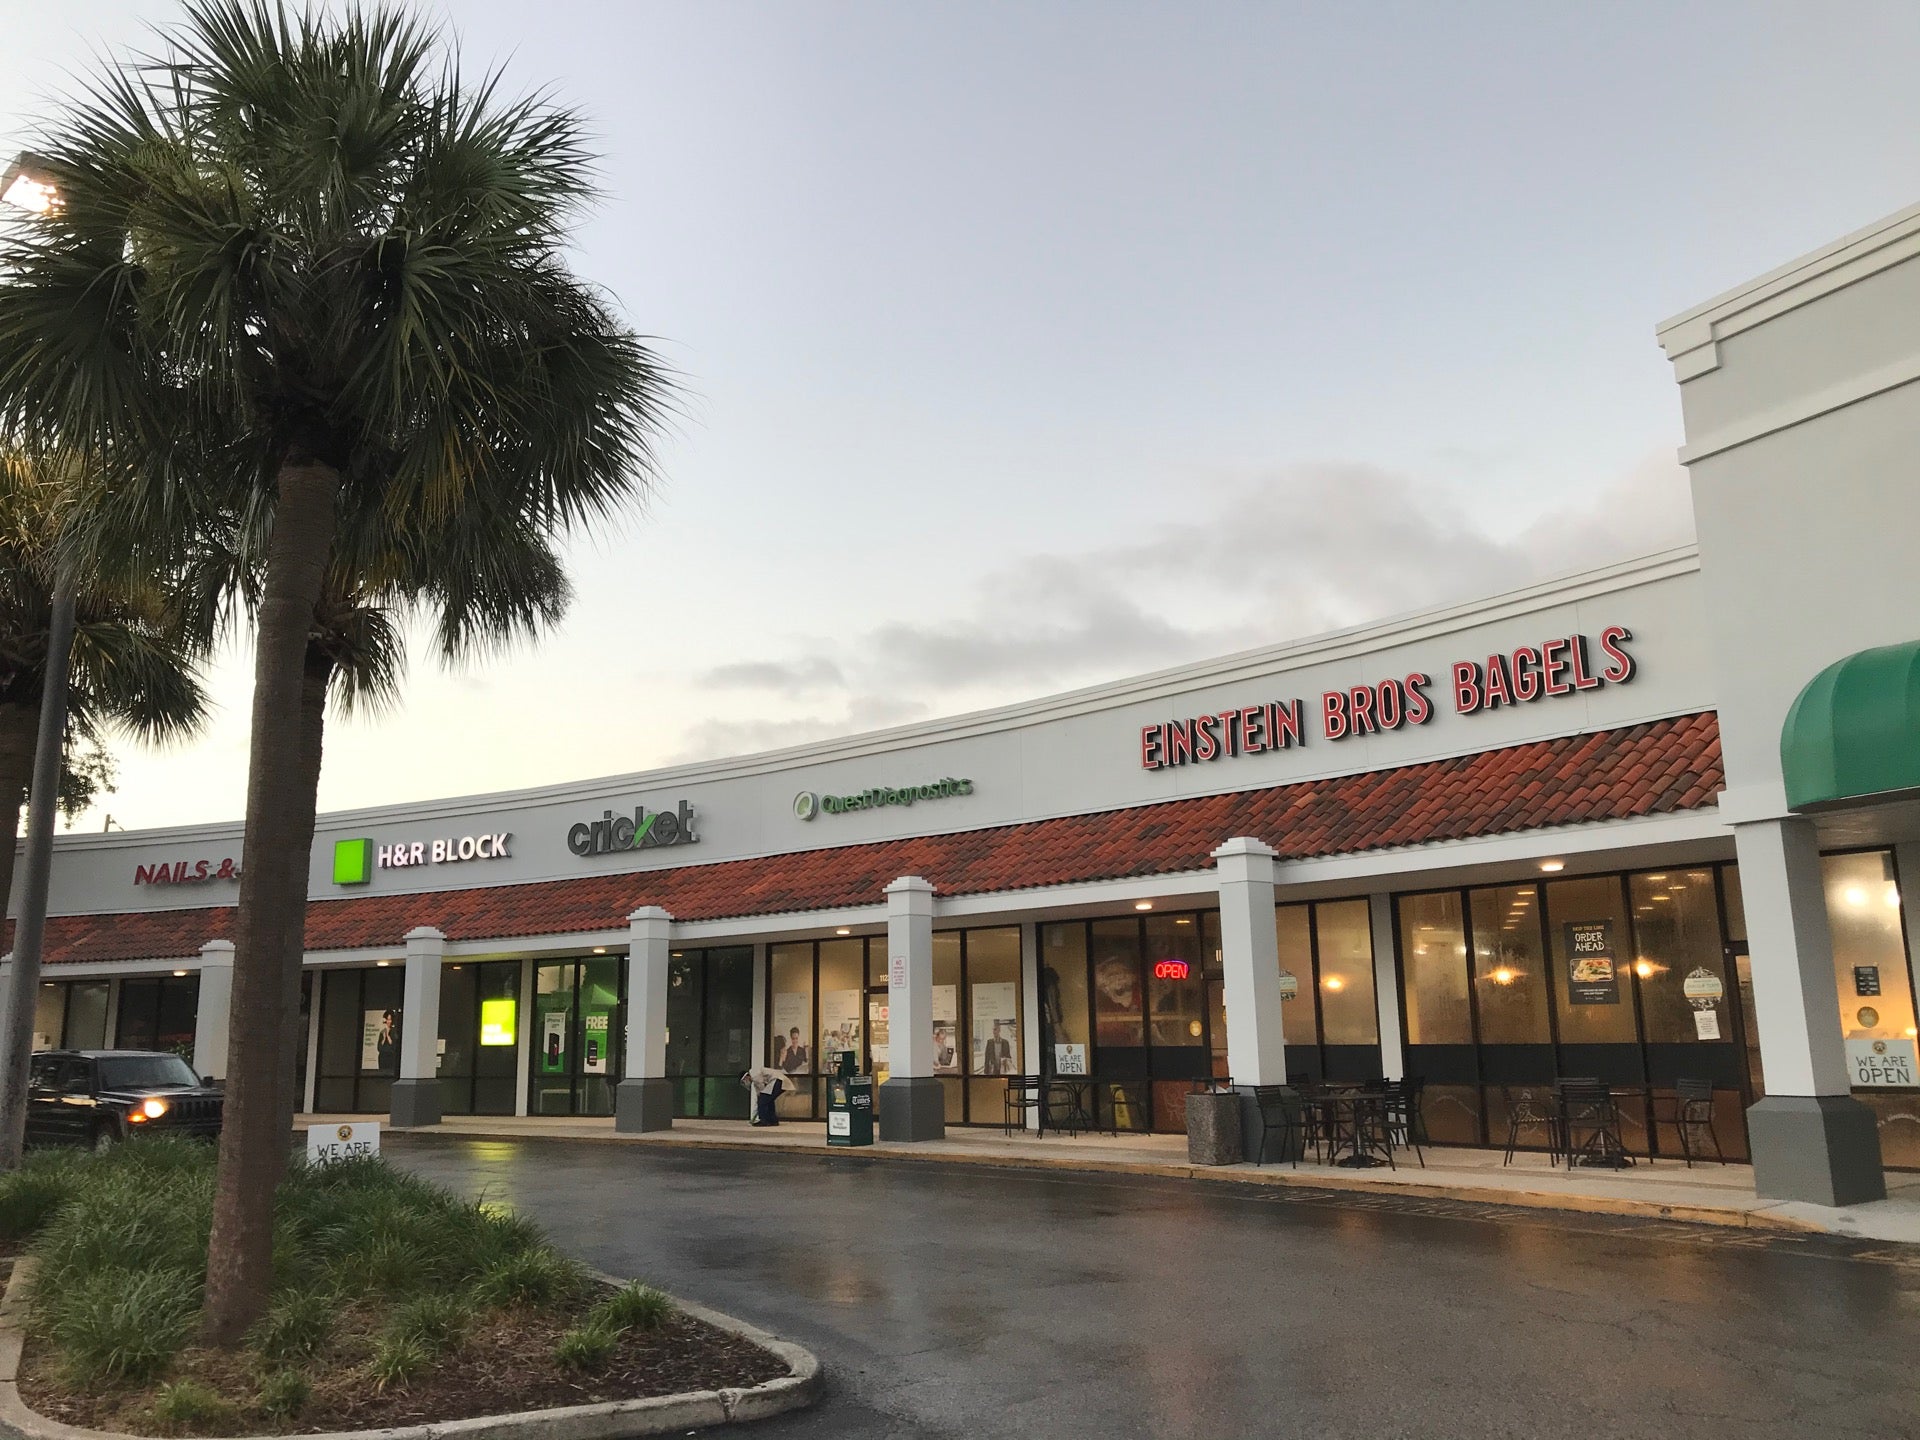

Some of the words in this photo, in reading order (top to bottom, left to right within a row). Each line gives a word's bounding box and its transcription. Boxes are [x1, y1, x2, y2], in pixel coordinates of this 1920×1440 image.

[1141, 698, 1303, 770] EINSTEIN
[1321, 673, 1431, 741] BROS
[1453, 625, 1634, 715] BAGELS
[821, 789, 872, 814] Quest
[873, 778, 972, 807] Diagnostics
[567, 800, 694, 856] cricket
[378, 841, 425, 868] H&R
[432, 832, 510, 863] BLOCK
[134, 860, 209, 885] NAILS
[216, 858, 236, 879] &
[1574, 931, 1604, 942] ORDER
[1574, 942, 1605, 952] AHEAD
[1155, 963, 1188, 979] OPEN
[585, 1015, 609, 1030] FREE
[1058, 1054, 1068, 1062] WE
[1070, 1054, 1082, 1062] ARE
[1855, 1056, 1876, 1067] WE
[1882, 1056, 1907, 1067] ARE
[1060, 1062, 1083, 1073] OPEN
[1858, 1068, 1910, 1083] OPEN
[317, 1143, 339, 1156] WE
[344, 1141, 371, 1154] ARE
